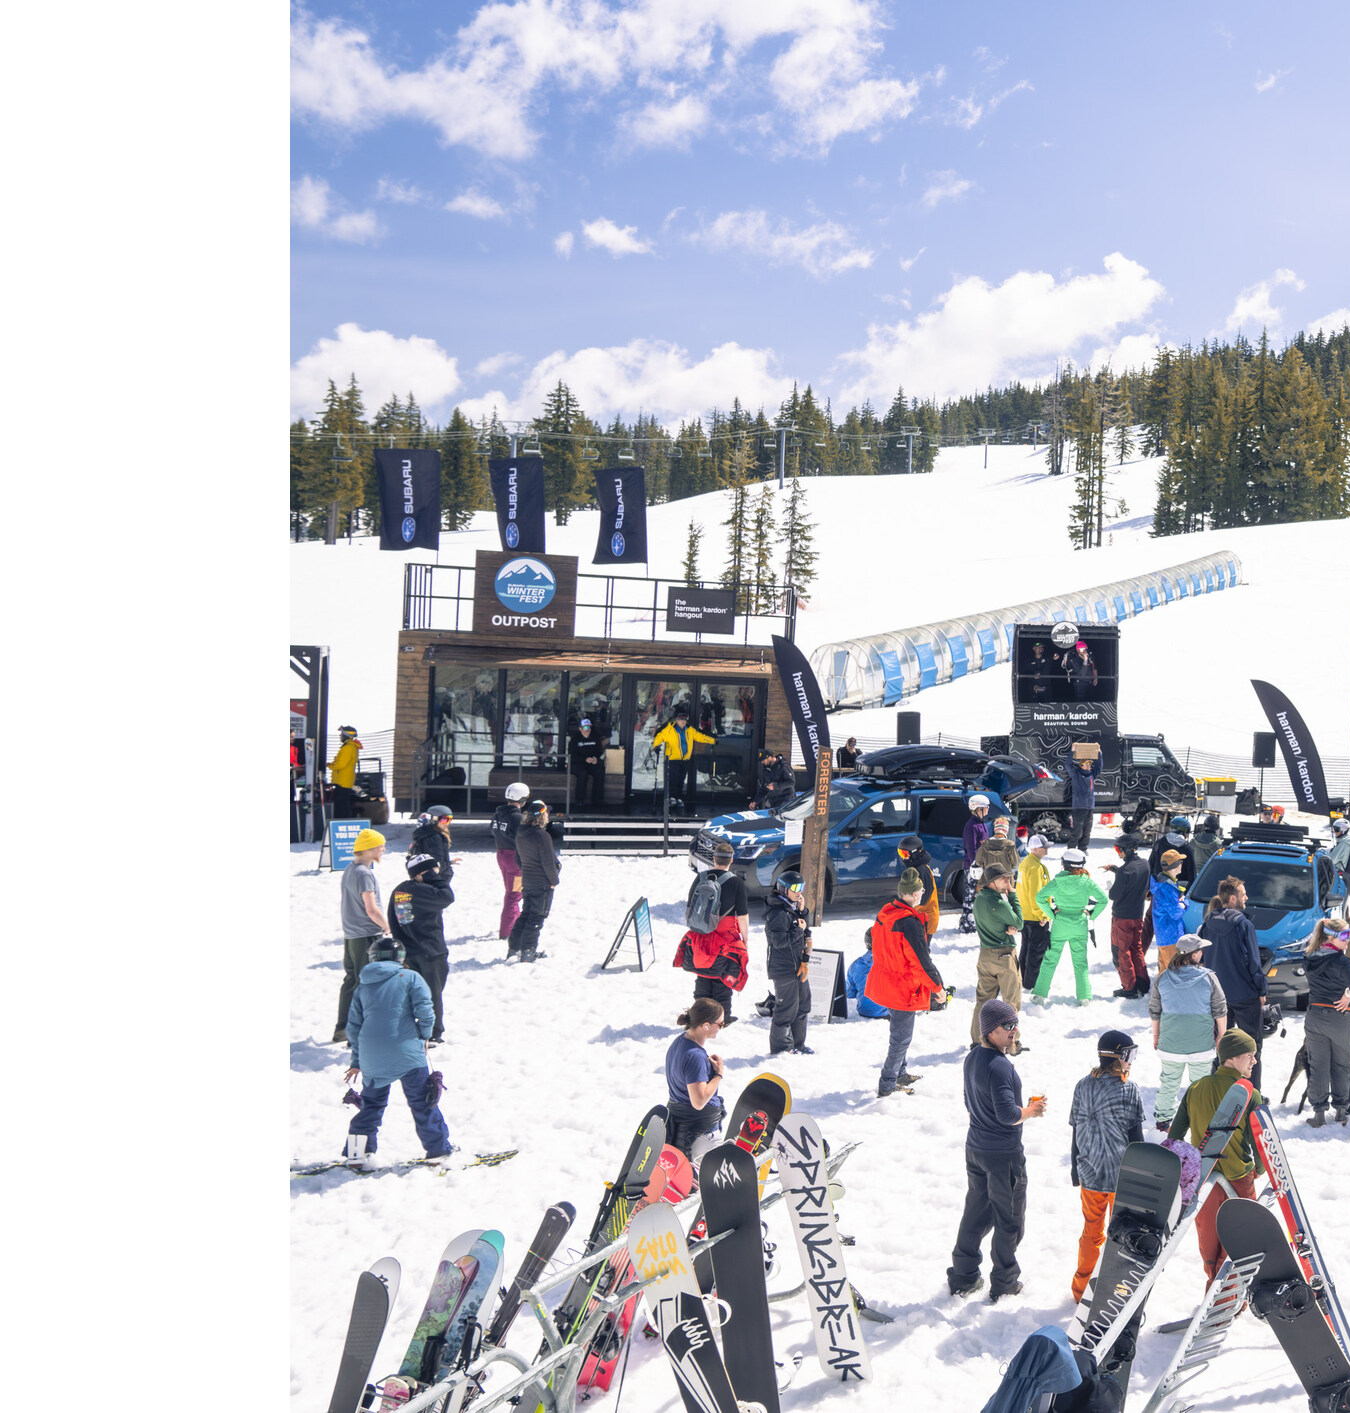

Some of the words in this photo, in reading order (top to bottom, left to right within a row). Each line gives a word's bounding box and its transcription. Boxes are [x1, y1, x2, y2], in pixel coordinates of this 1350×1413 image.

[402, 459, 413, 514] SUBARU
[508, 467, 518, 520] SUBARU
[614, 478, 623, 529] SUBARU
[507, 587, 546, 596] WINTER
[519, 595, 545, 604] FEST
[491, 614, 557, 629] OUTPOST
[674, 611, 703, 619] hangout
[816, 752, 831, 816] FORESTER
